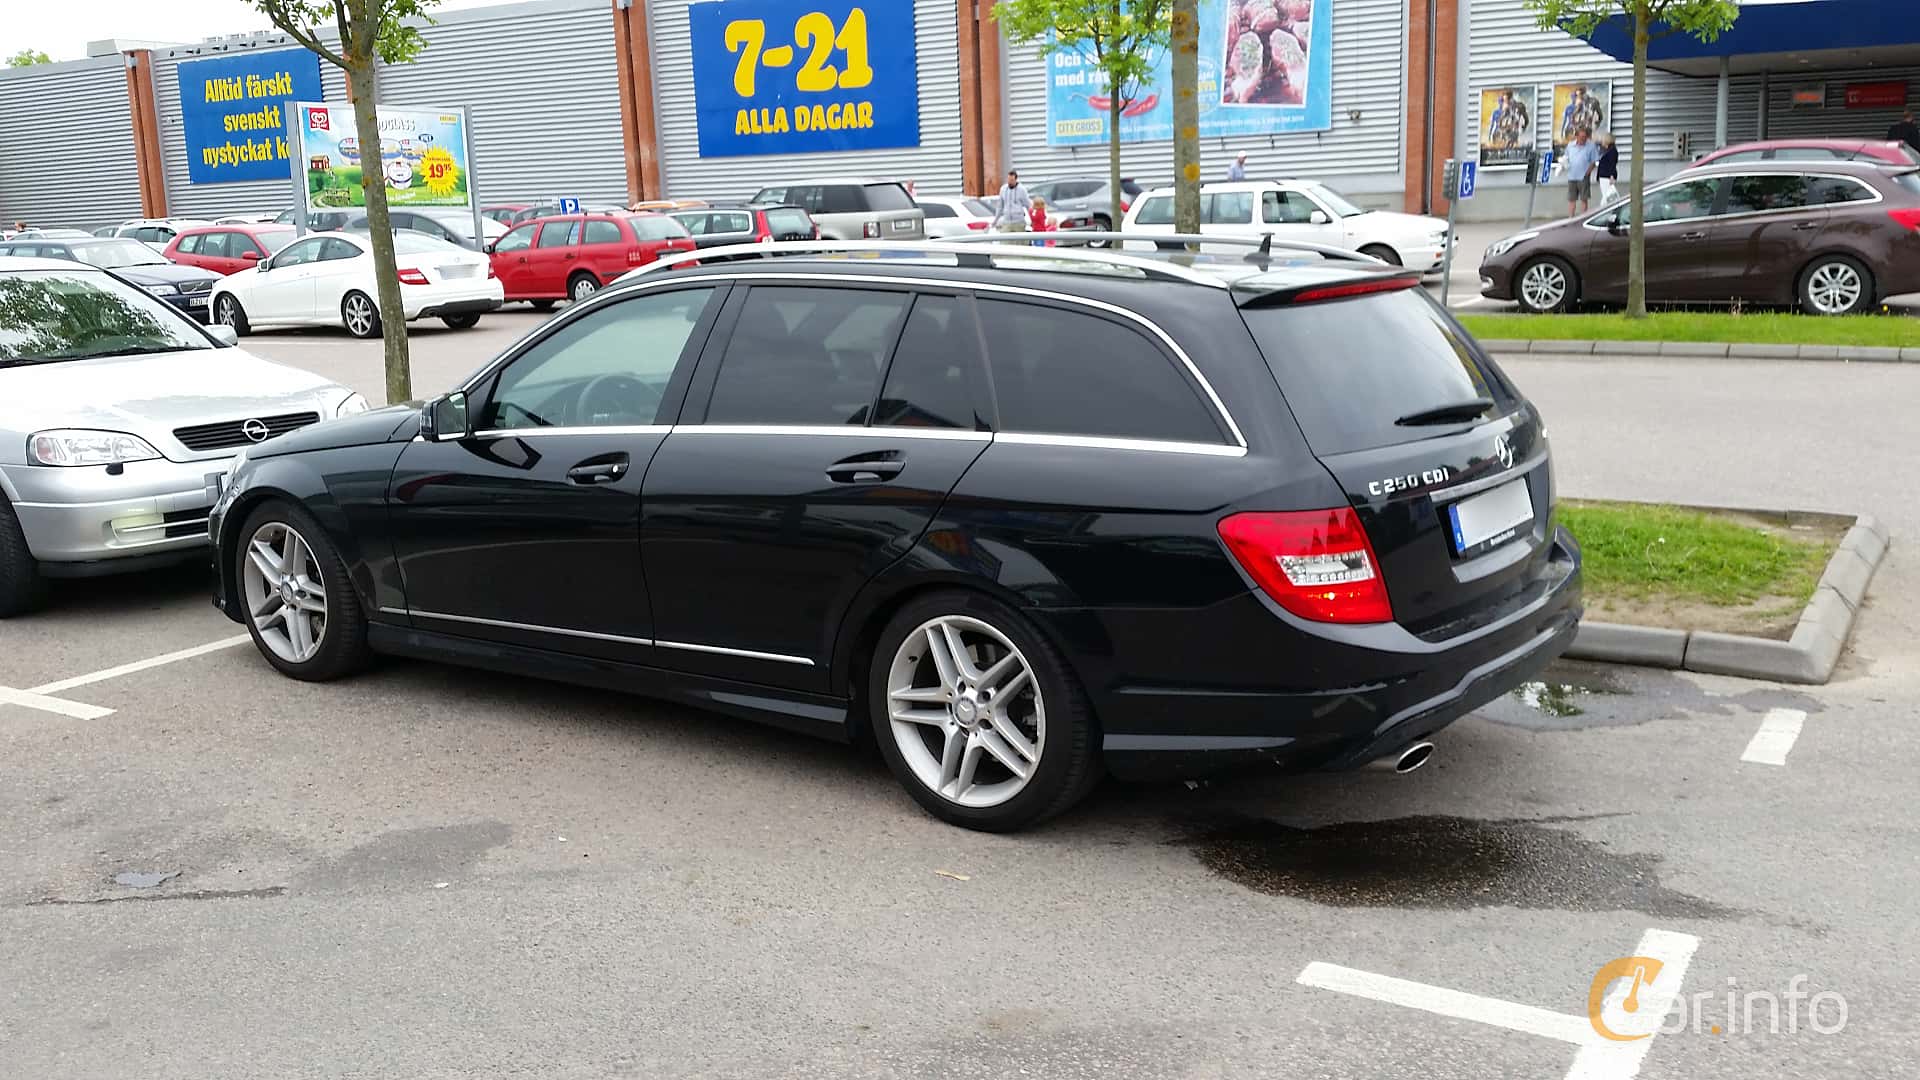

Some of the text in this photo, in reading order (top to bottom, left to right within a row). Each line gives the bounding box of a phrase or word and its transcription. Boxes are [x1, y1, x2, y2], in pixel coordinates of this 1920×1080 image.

[724, 7, 873, 97] 7-21
[205, 71, 292, 103] Alltid färskt
[1055, 70, 1084, 86] med
[223, 104, 281, 132] svenskt
[735, 101, 873, 135] ALLA DAGAR
[202, 137, 273, 168] nystyckat
[565, 199, 576, 214] P
[1368, 467, 1449, 496] C 250 CDI
